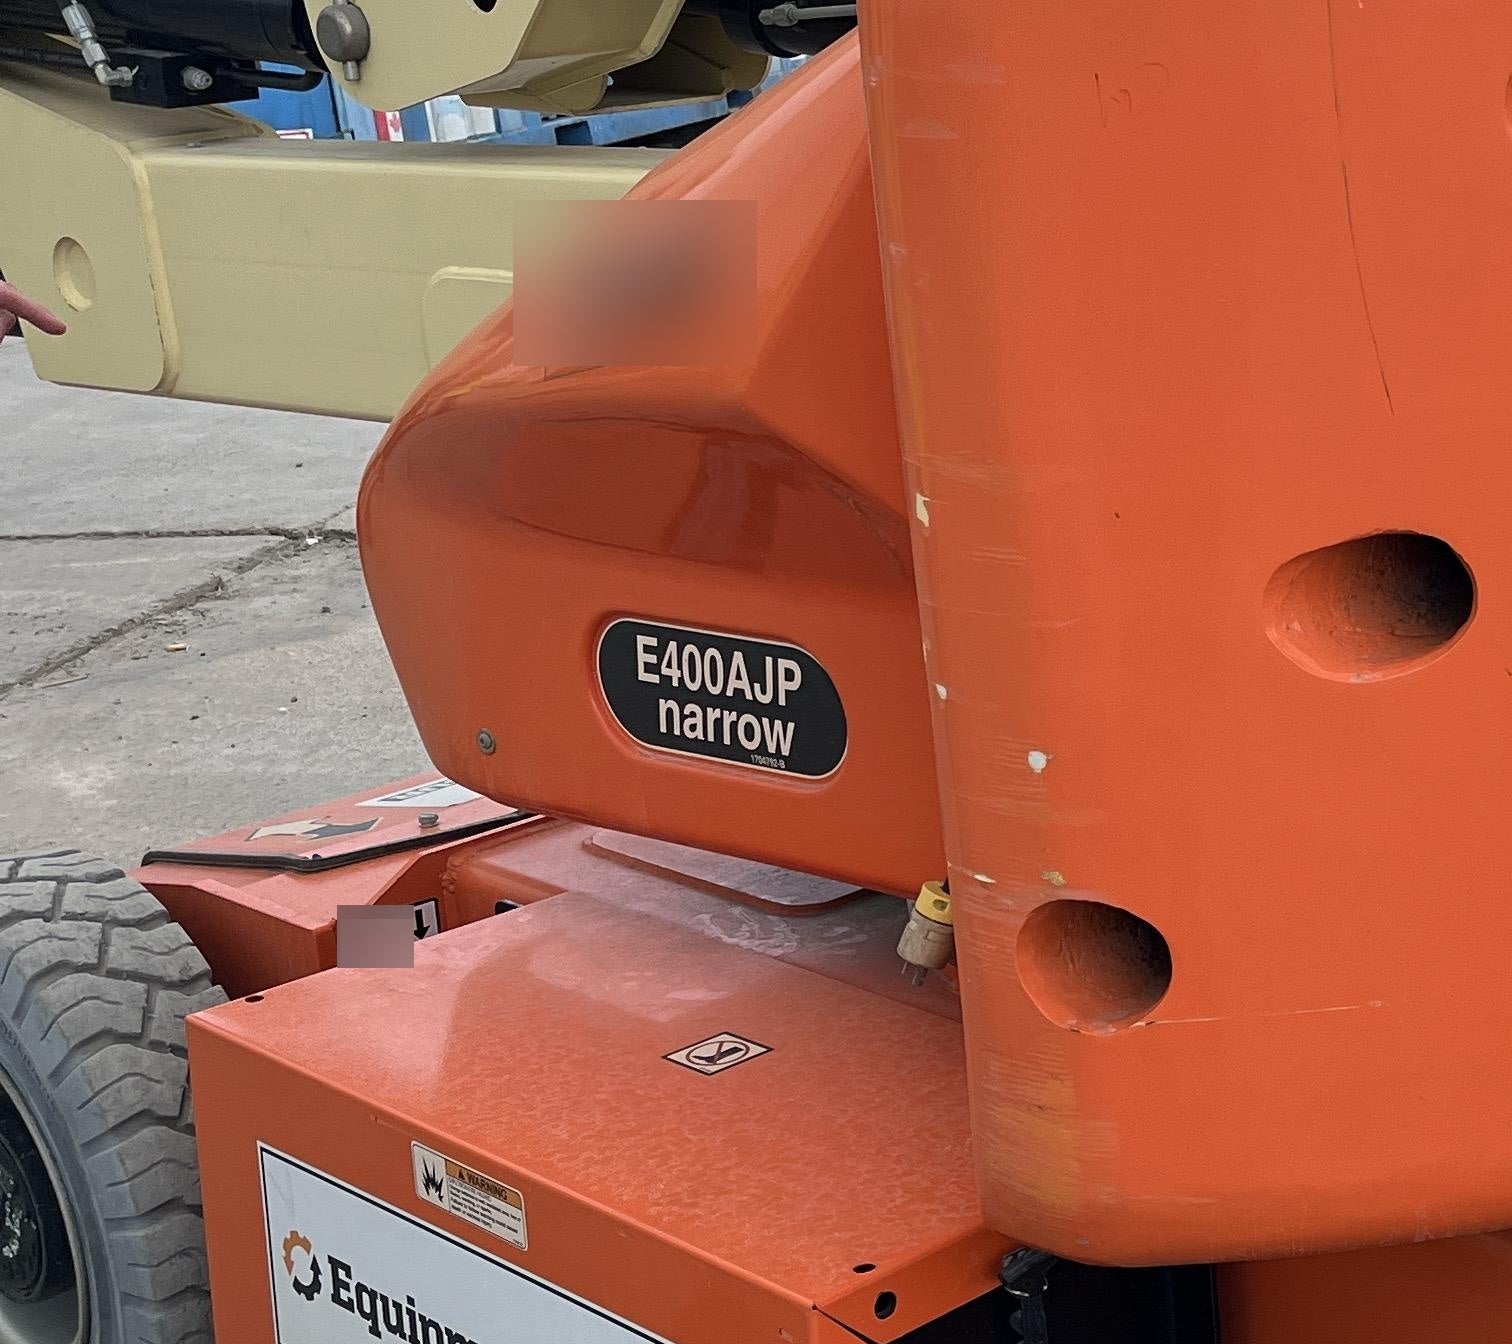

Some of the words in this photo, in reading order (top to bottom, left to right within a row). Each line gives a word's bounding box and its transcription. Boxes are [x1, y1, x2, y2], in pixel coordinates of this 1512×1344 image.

[635, 634, 802, 707] E400AJP
[658, 697, 796, 757] narrow
[466, 1171, 508, 1201] WARNING
